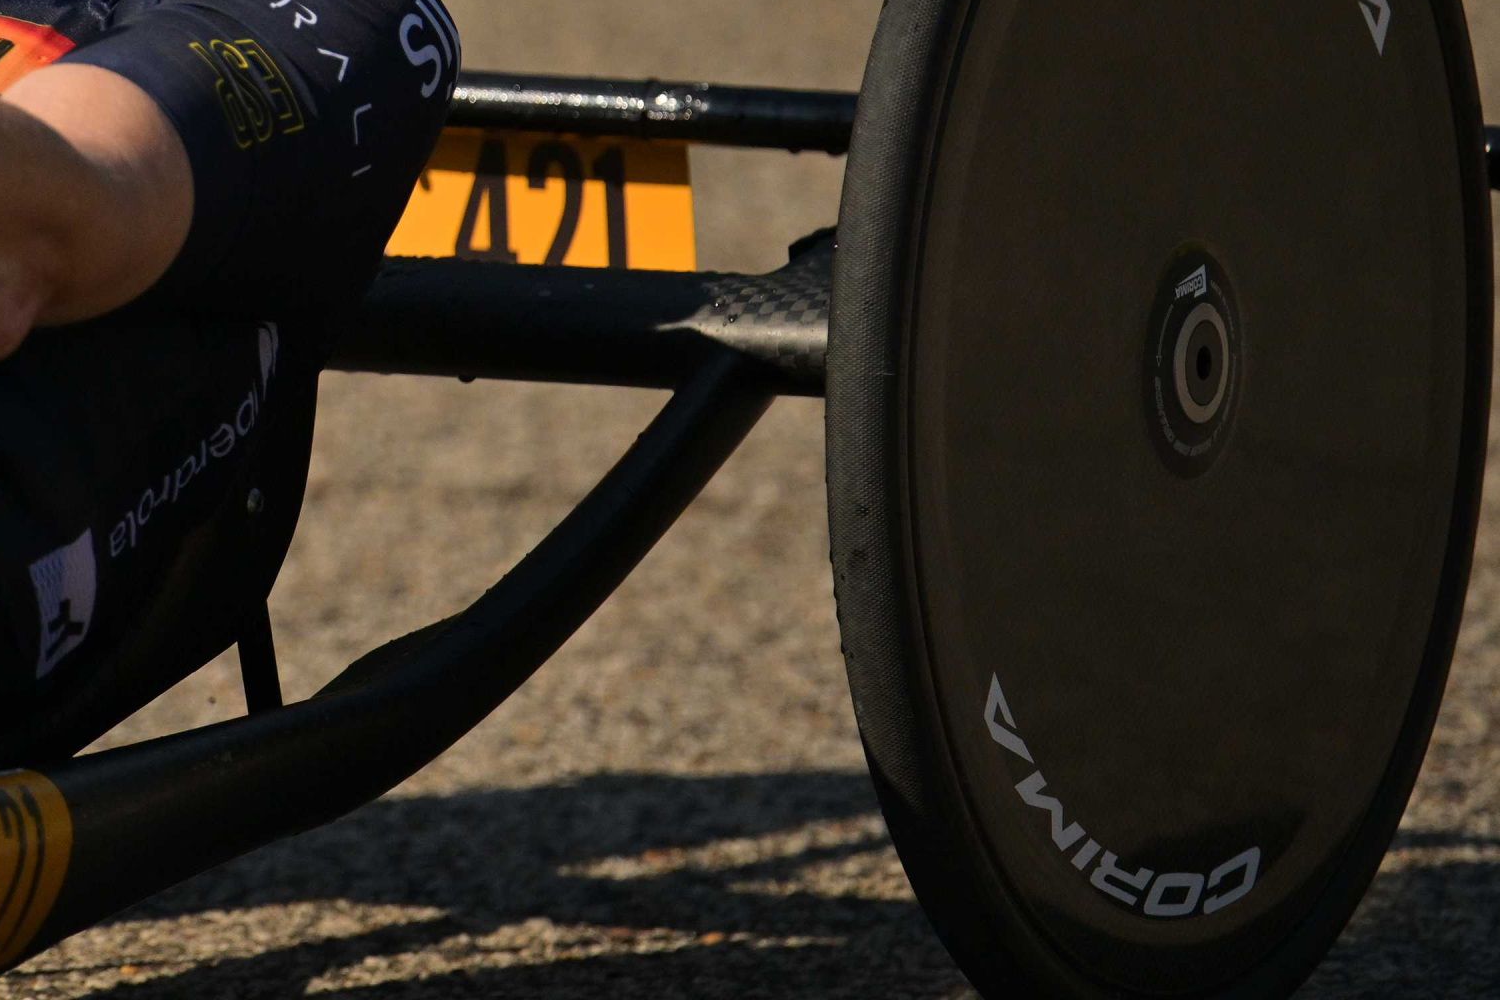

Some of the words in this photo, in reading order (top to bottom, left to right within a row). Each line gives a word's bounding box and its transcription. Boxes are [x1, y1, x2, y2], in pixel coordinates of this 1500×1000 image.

[454, 138, 629, 268] 421
[1174, 272, 1204, 300] CORIMA
[983, 671, 1263, 916] CORIMA
